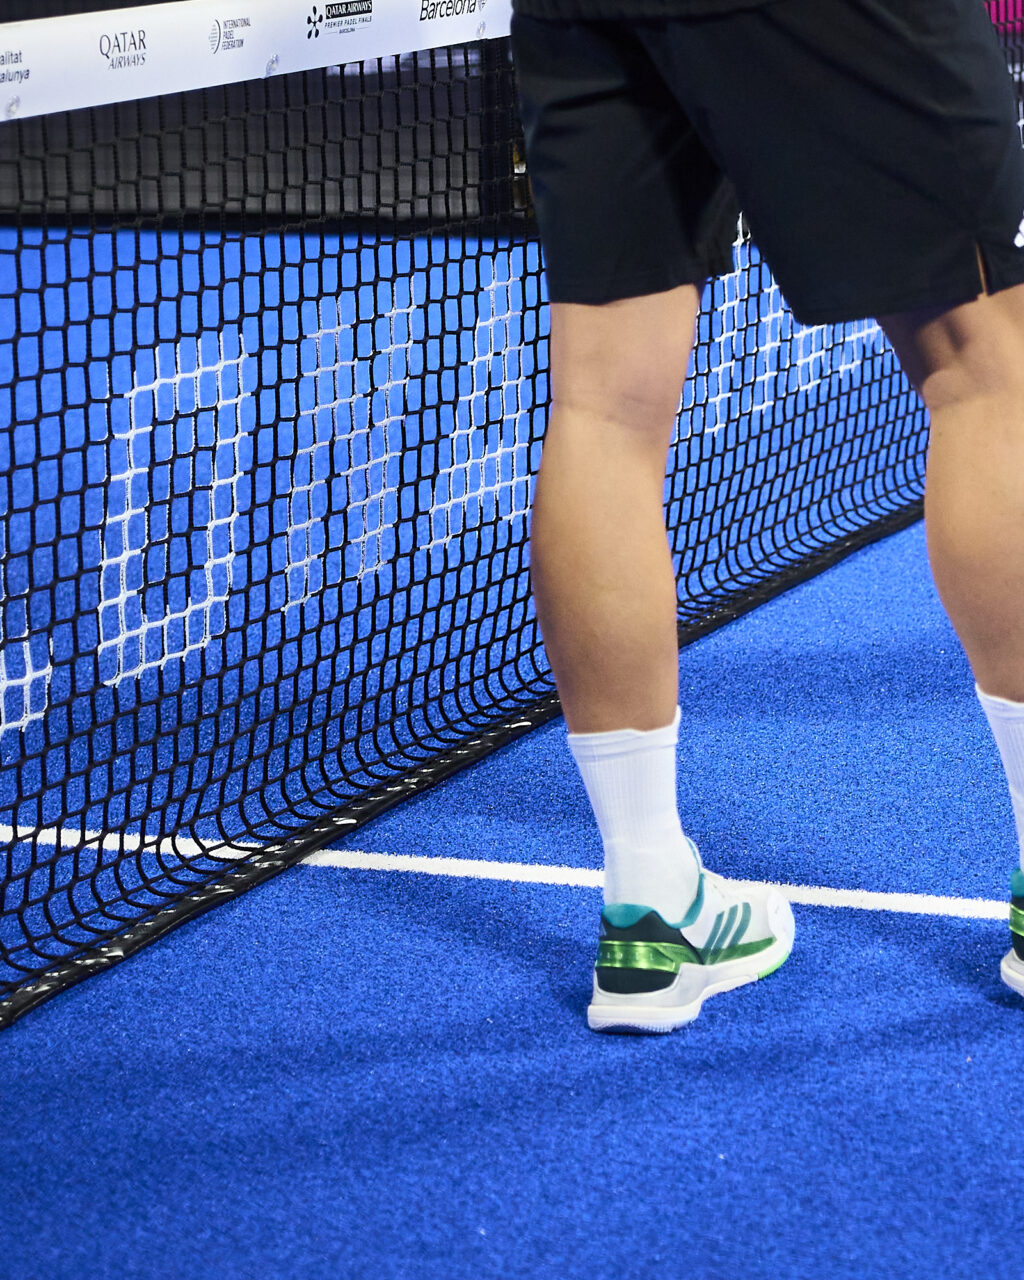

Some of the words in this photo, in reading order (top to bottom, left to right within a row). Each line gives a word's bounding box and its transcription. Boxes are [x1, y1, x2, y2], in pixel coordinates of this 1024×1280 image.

[326, 4, 347, 18] QATAR
[346, 0, 372, 14] AIRWAYS
[99, 29, 147, 60] QATAR
[108, 52, 147, 70] AIRWAYS
